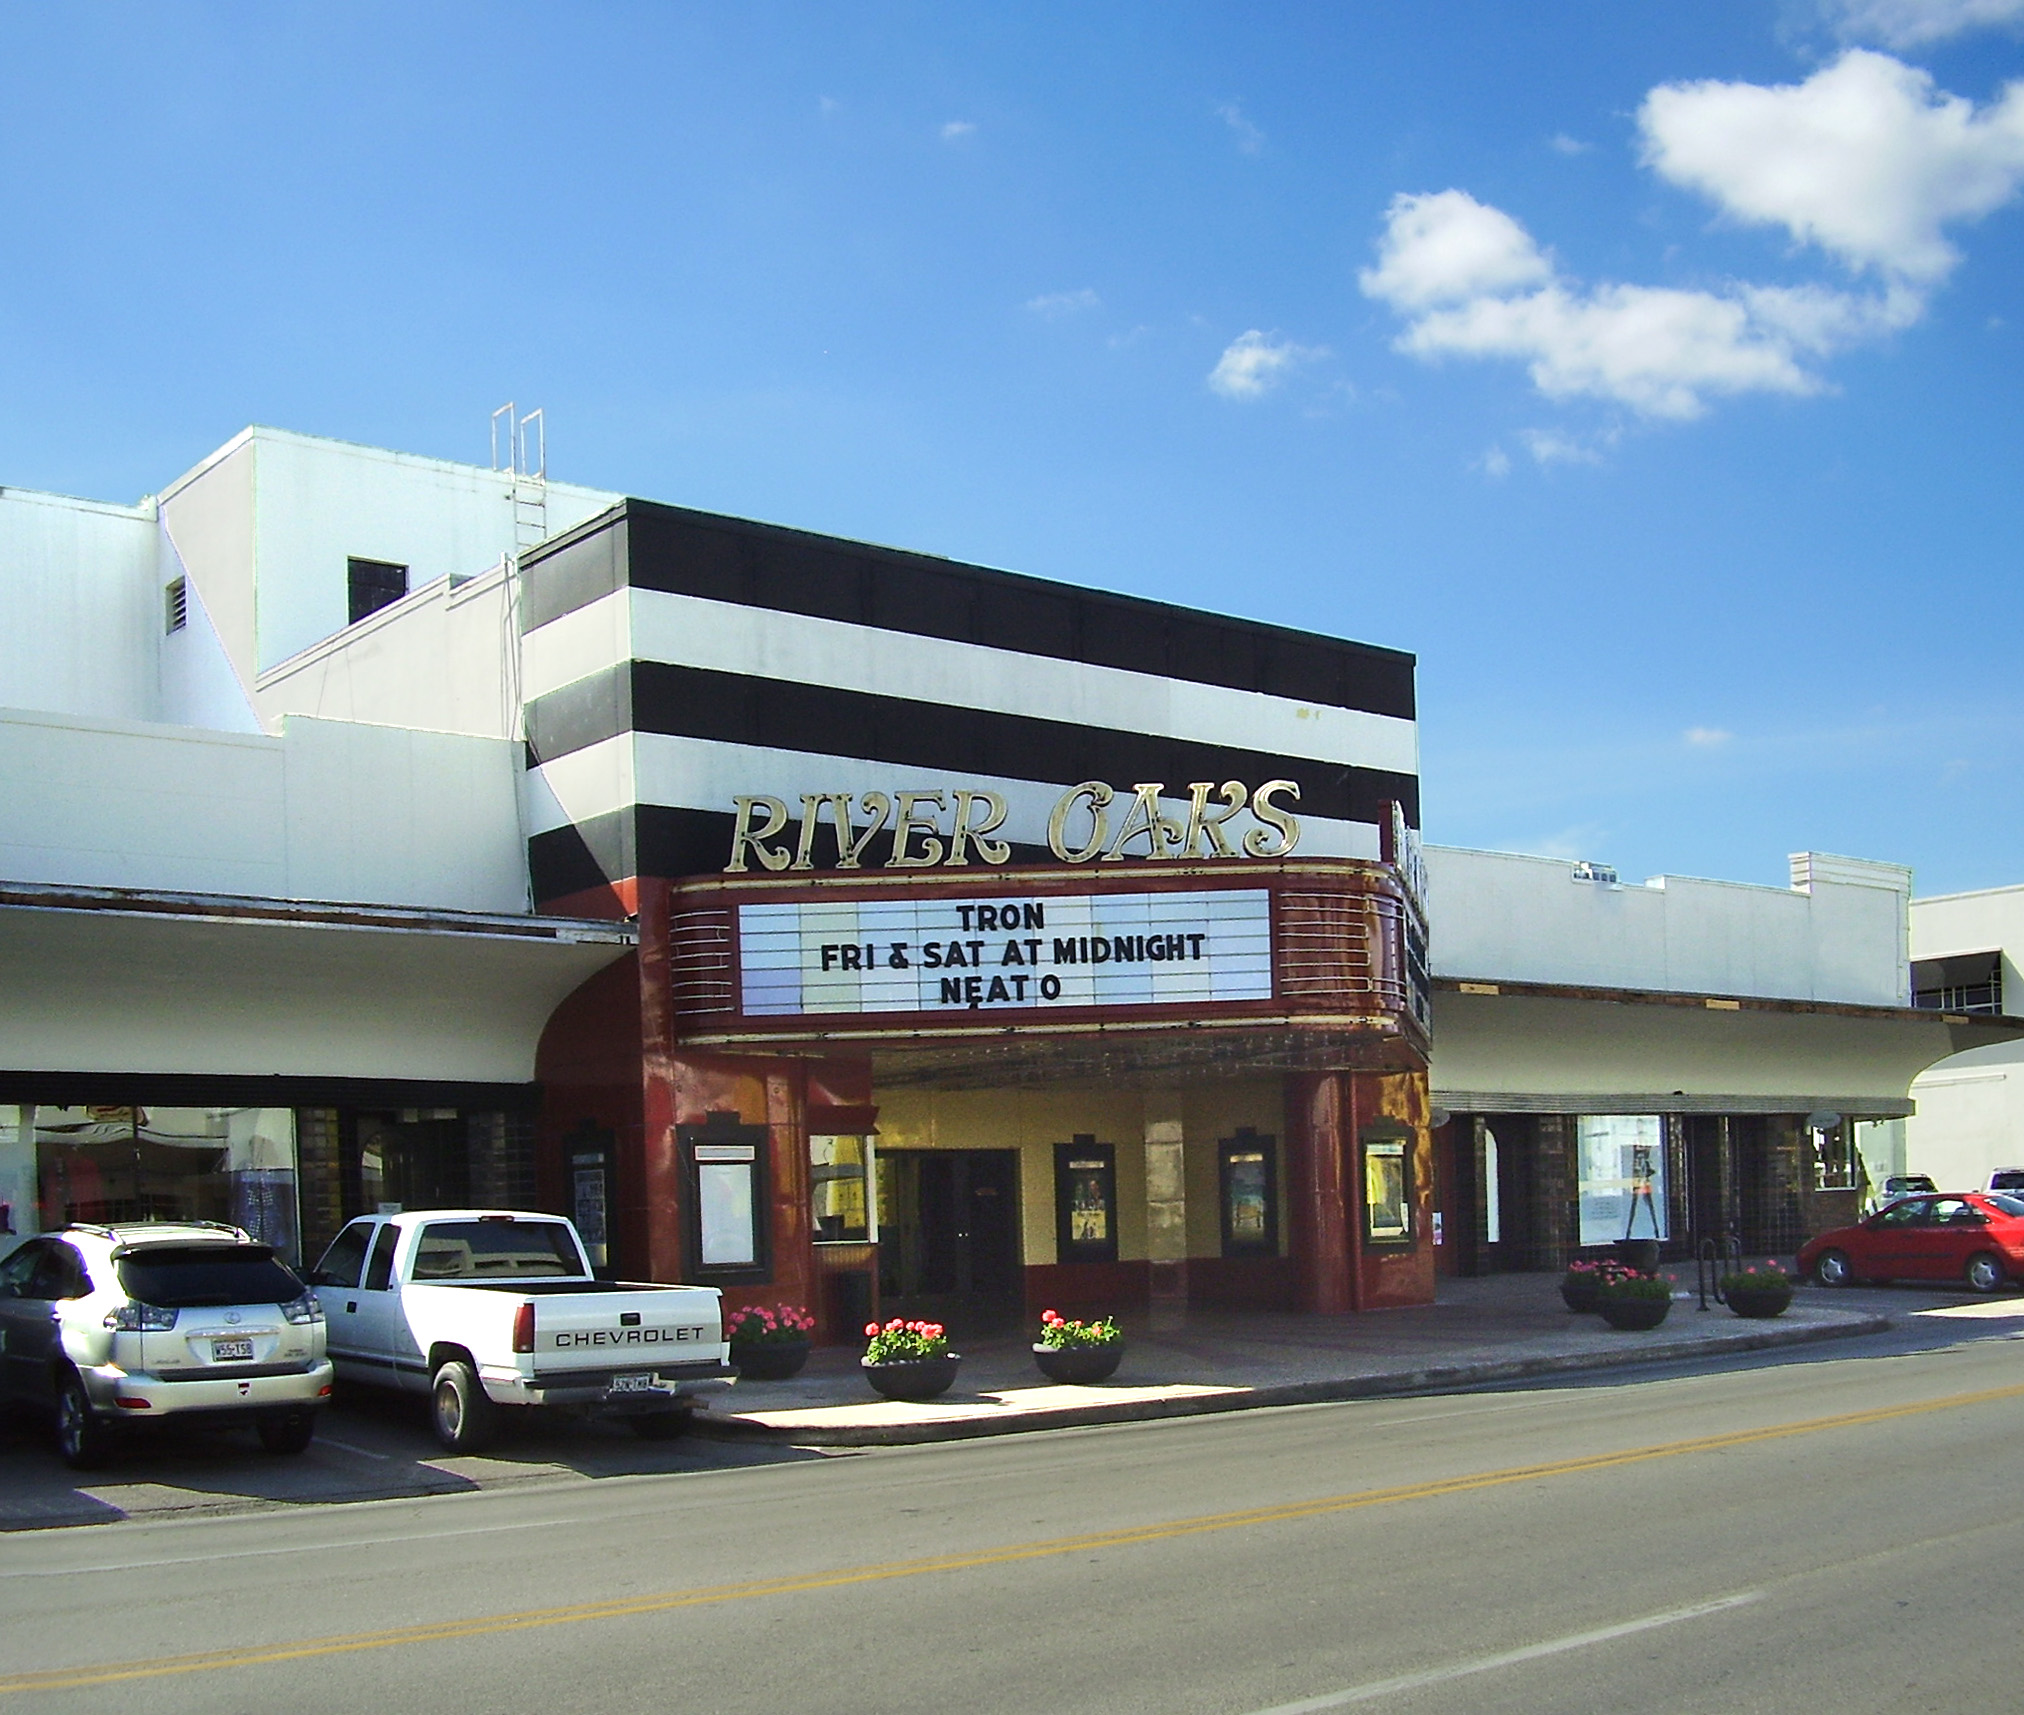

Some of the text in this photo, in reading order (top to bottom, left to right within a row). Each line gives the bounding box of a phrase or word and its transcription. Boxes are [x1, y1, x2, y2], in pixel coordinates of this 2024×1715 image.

[723, 779, 1300, 872] RIVER OAKS
[956, 902, 1044, 931] TRON
[821, 933, 1206, 971] FRI & SAT AT MIDNIGHT
[555, 1327, 704, 1347] CHEVROLET
